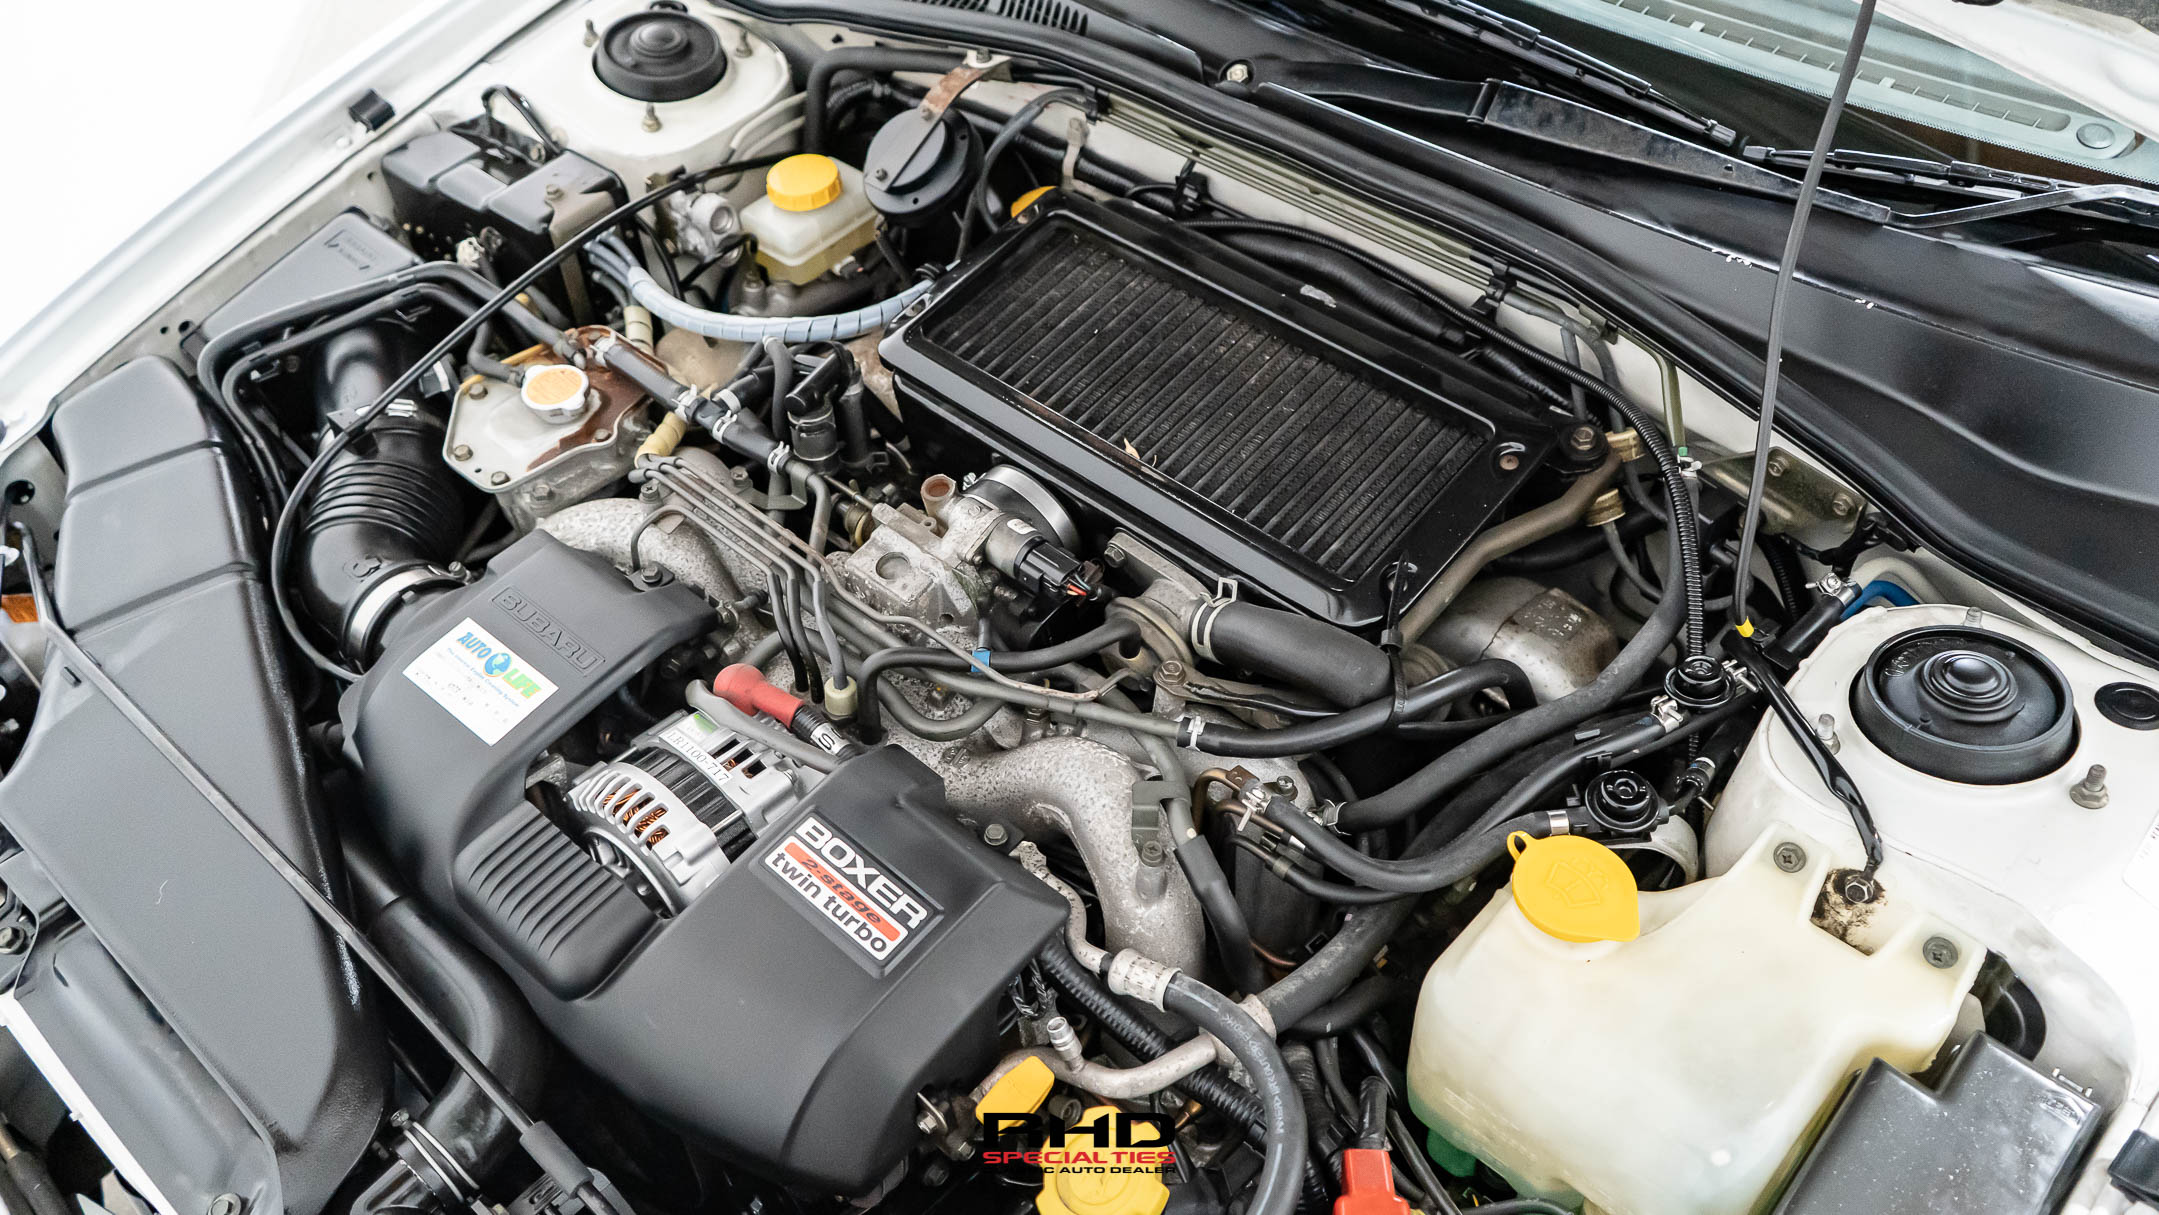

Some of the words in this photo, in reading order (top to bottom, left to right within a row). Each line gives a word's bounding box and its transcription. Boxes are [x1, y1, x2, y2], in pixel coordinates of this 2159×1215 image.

[456, 631, 493, 660] AUTO
[502, 667, 542, 700] LIFE
[502, 594, 599, 670] SUBARU
[666, 730, 730, 783] LR1100-717
[771, 852, 822, 899] twin
[822, 894, 887, 953] turbo
[795, 816, 928, 930] BOXER
[800, 858, 882, 925] 2-stage
